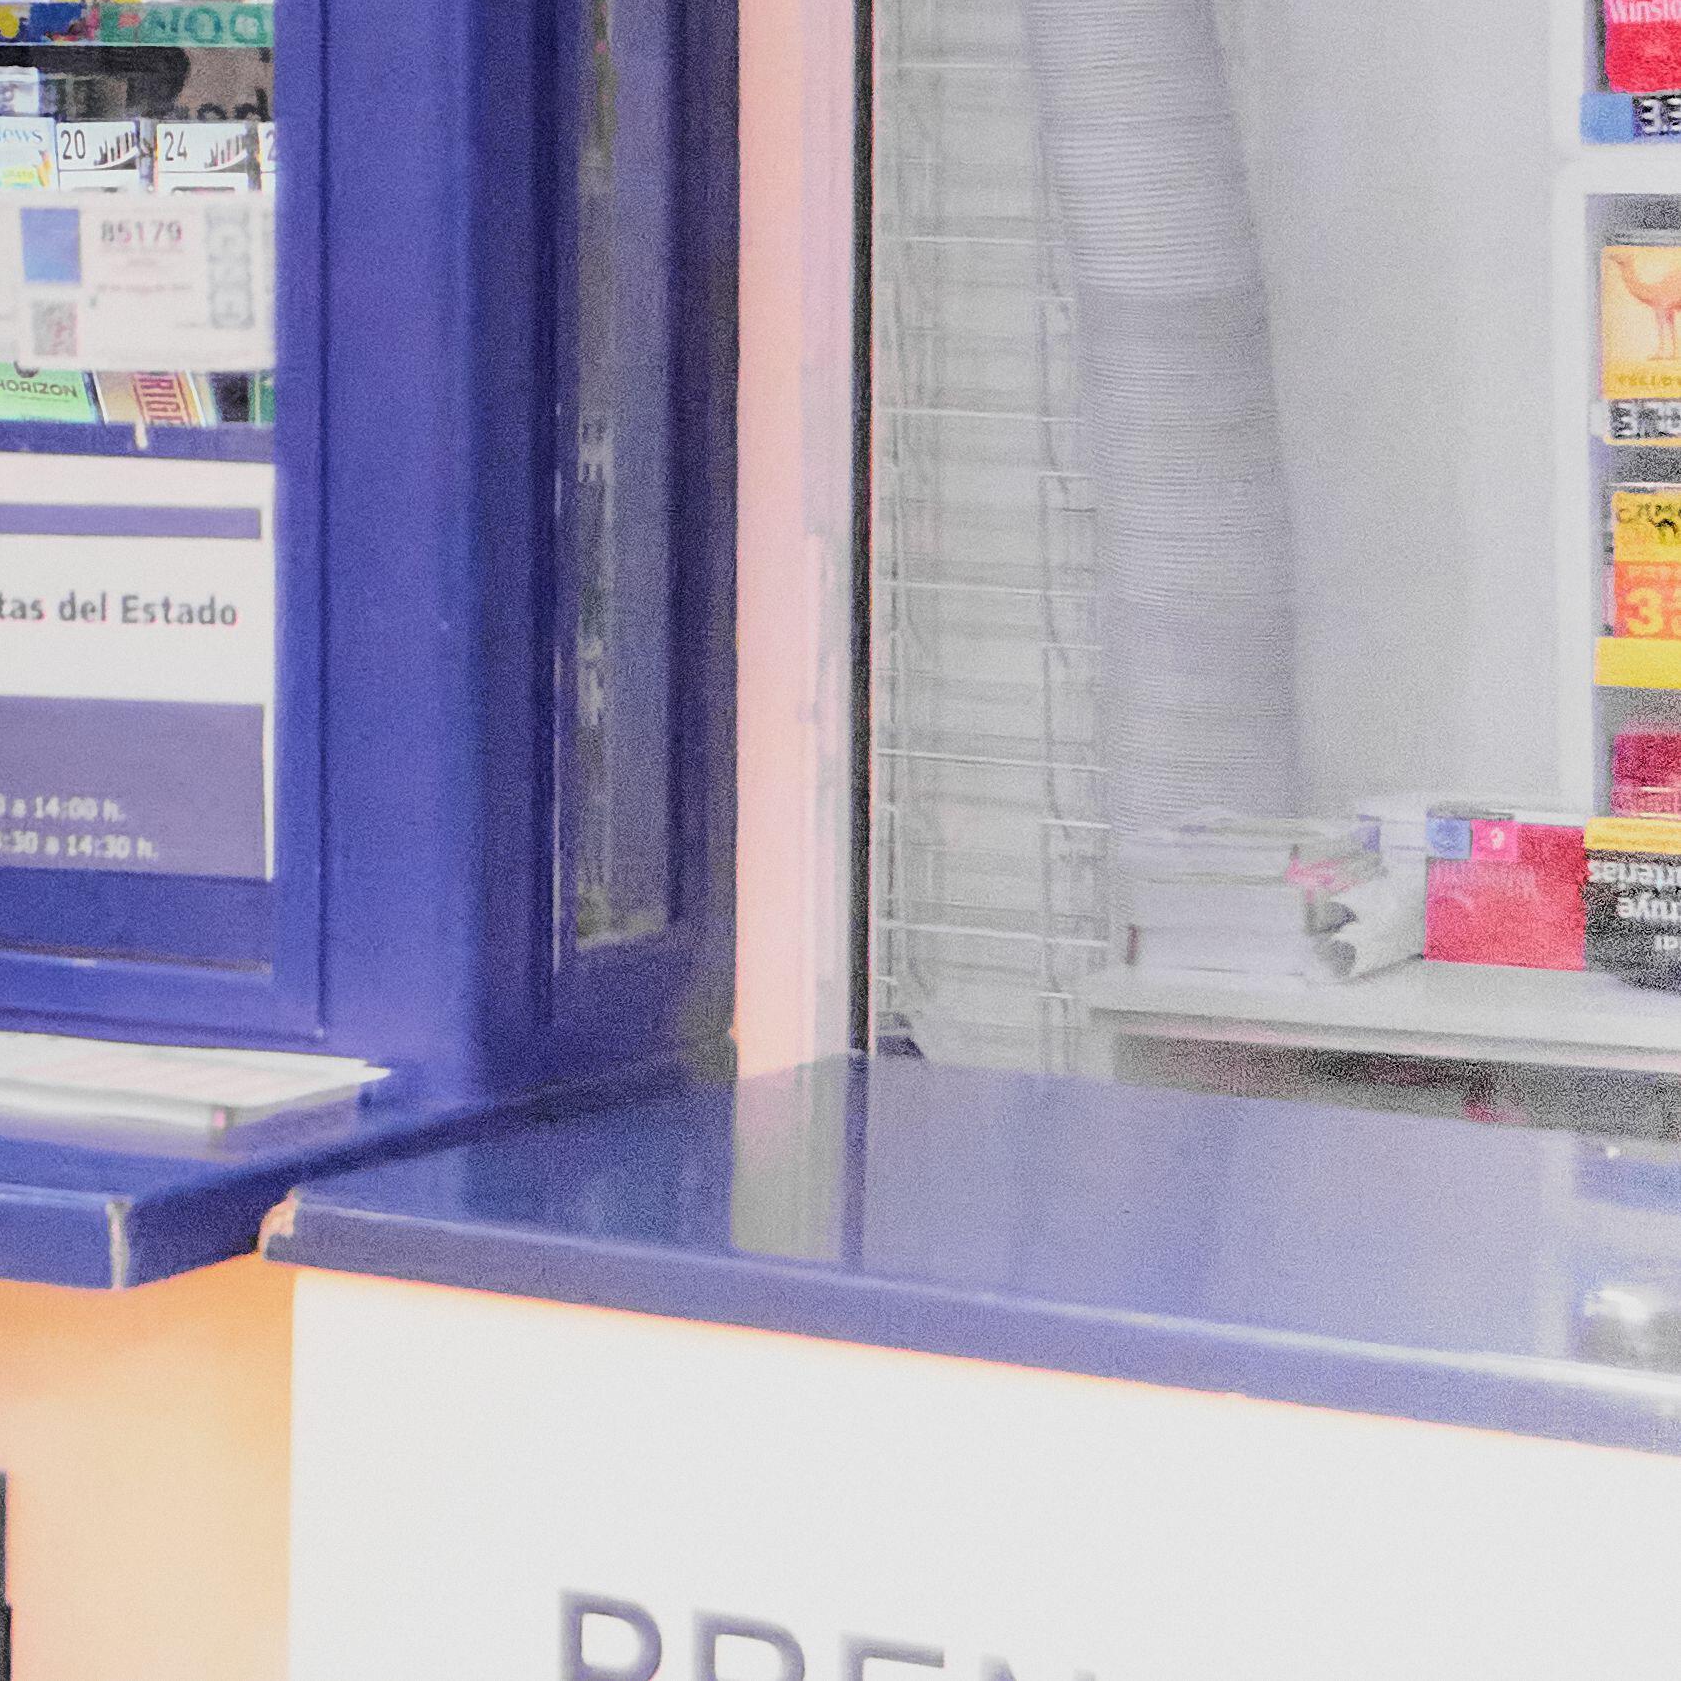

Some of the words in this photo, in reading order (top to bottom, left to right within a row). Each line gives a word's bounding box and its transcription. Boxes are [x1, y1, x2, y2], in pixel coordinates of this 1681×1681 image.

[60, 129, 86, 160] 20
[164, 131, 188, 161] 24
[57, 591, 106, 623] del
[121, 594, 240, 627] Estado
[12, 797, 27, 819] a
[45, 835, 60, 856] a
